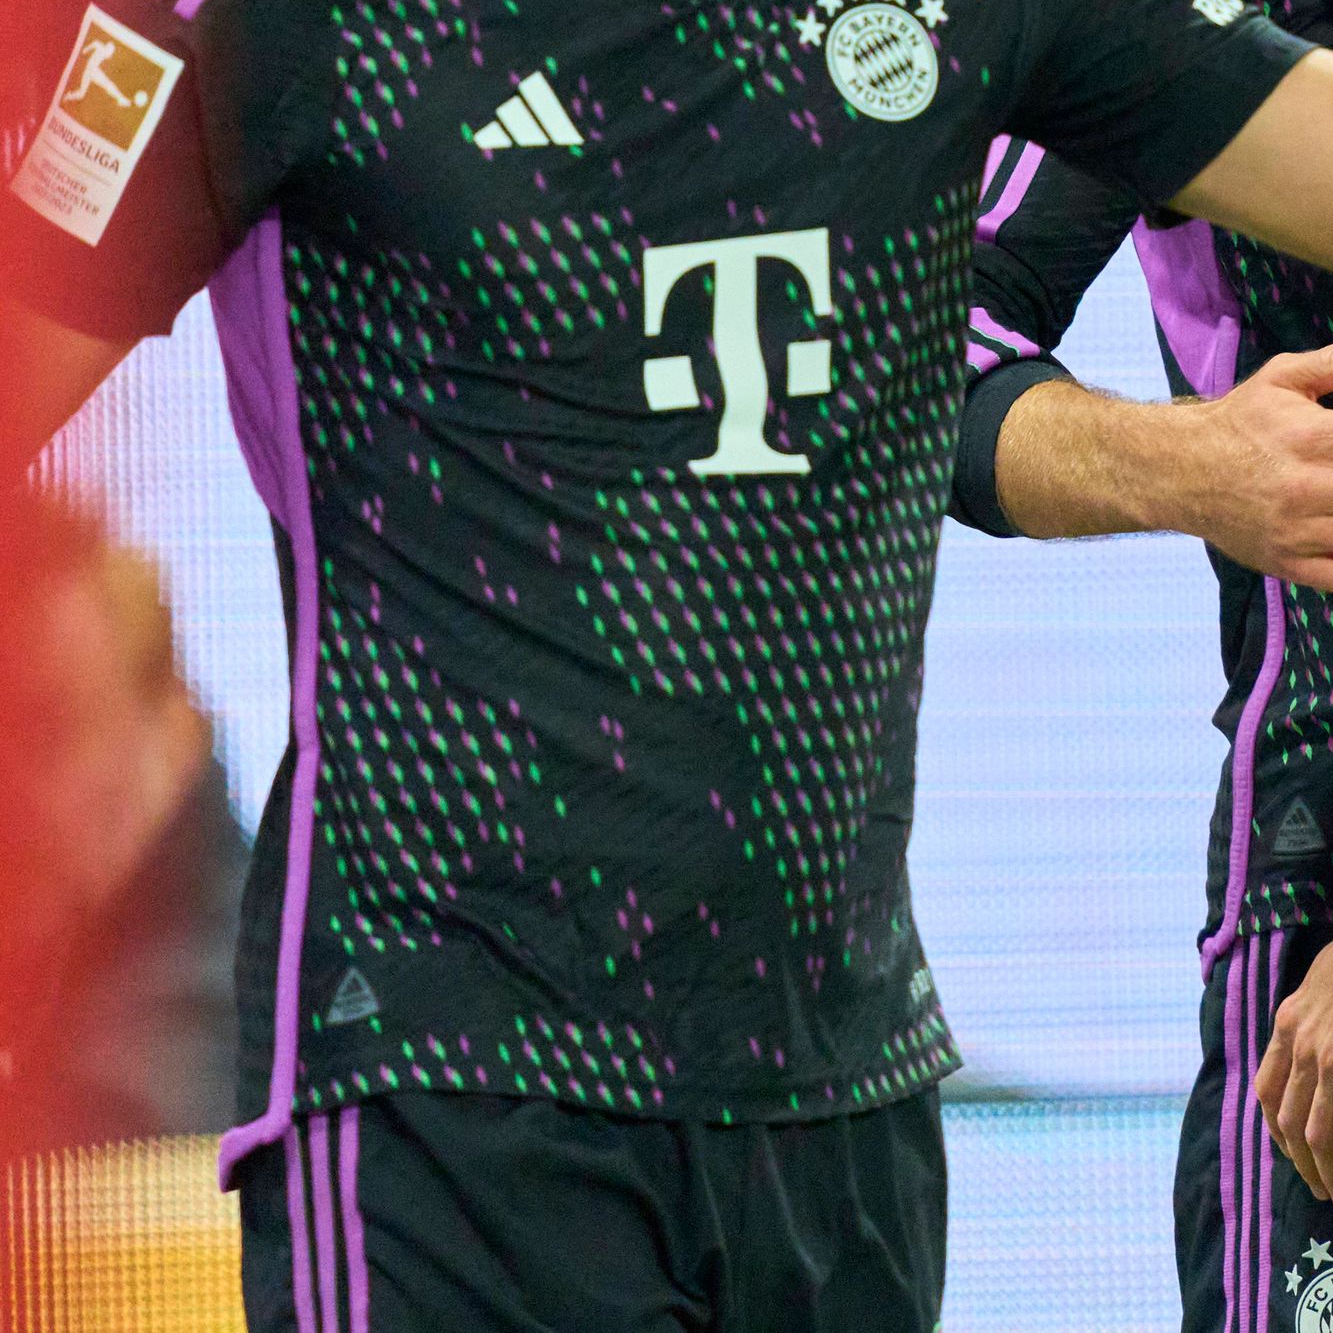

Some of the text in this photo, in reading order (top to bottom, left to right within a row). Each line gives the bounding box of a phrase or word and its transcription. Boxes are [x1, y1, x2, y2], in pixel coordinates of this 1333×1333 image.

[849, 14, 922, 48] BAYERN
[643, 227, 832, 476] T
[1306, 1287, 1329, 1313] FC
